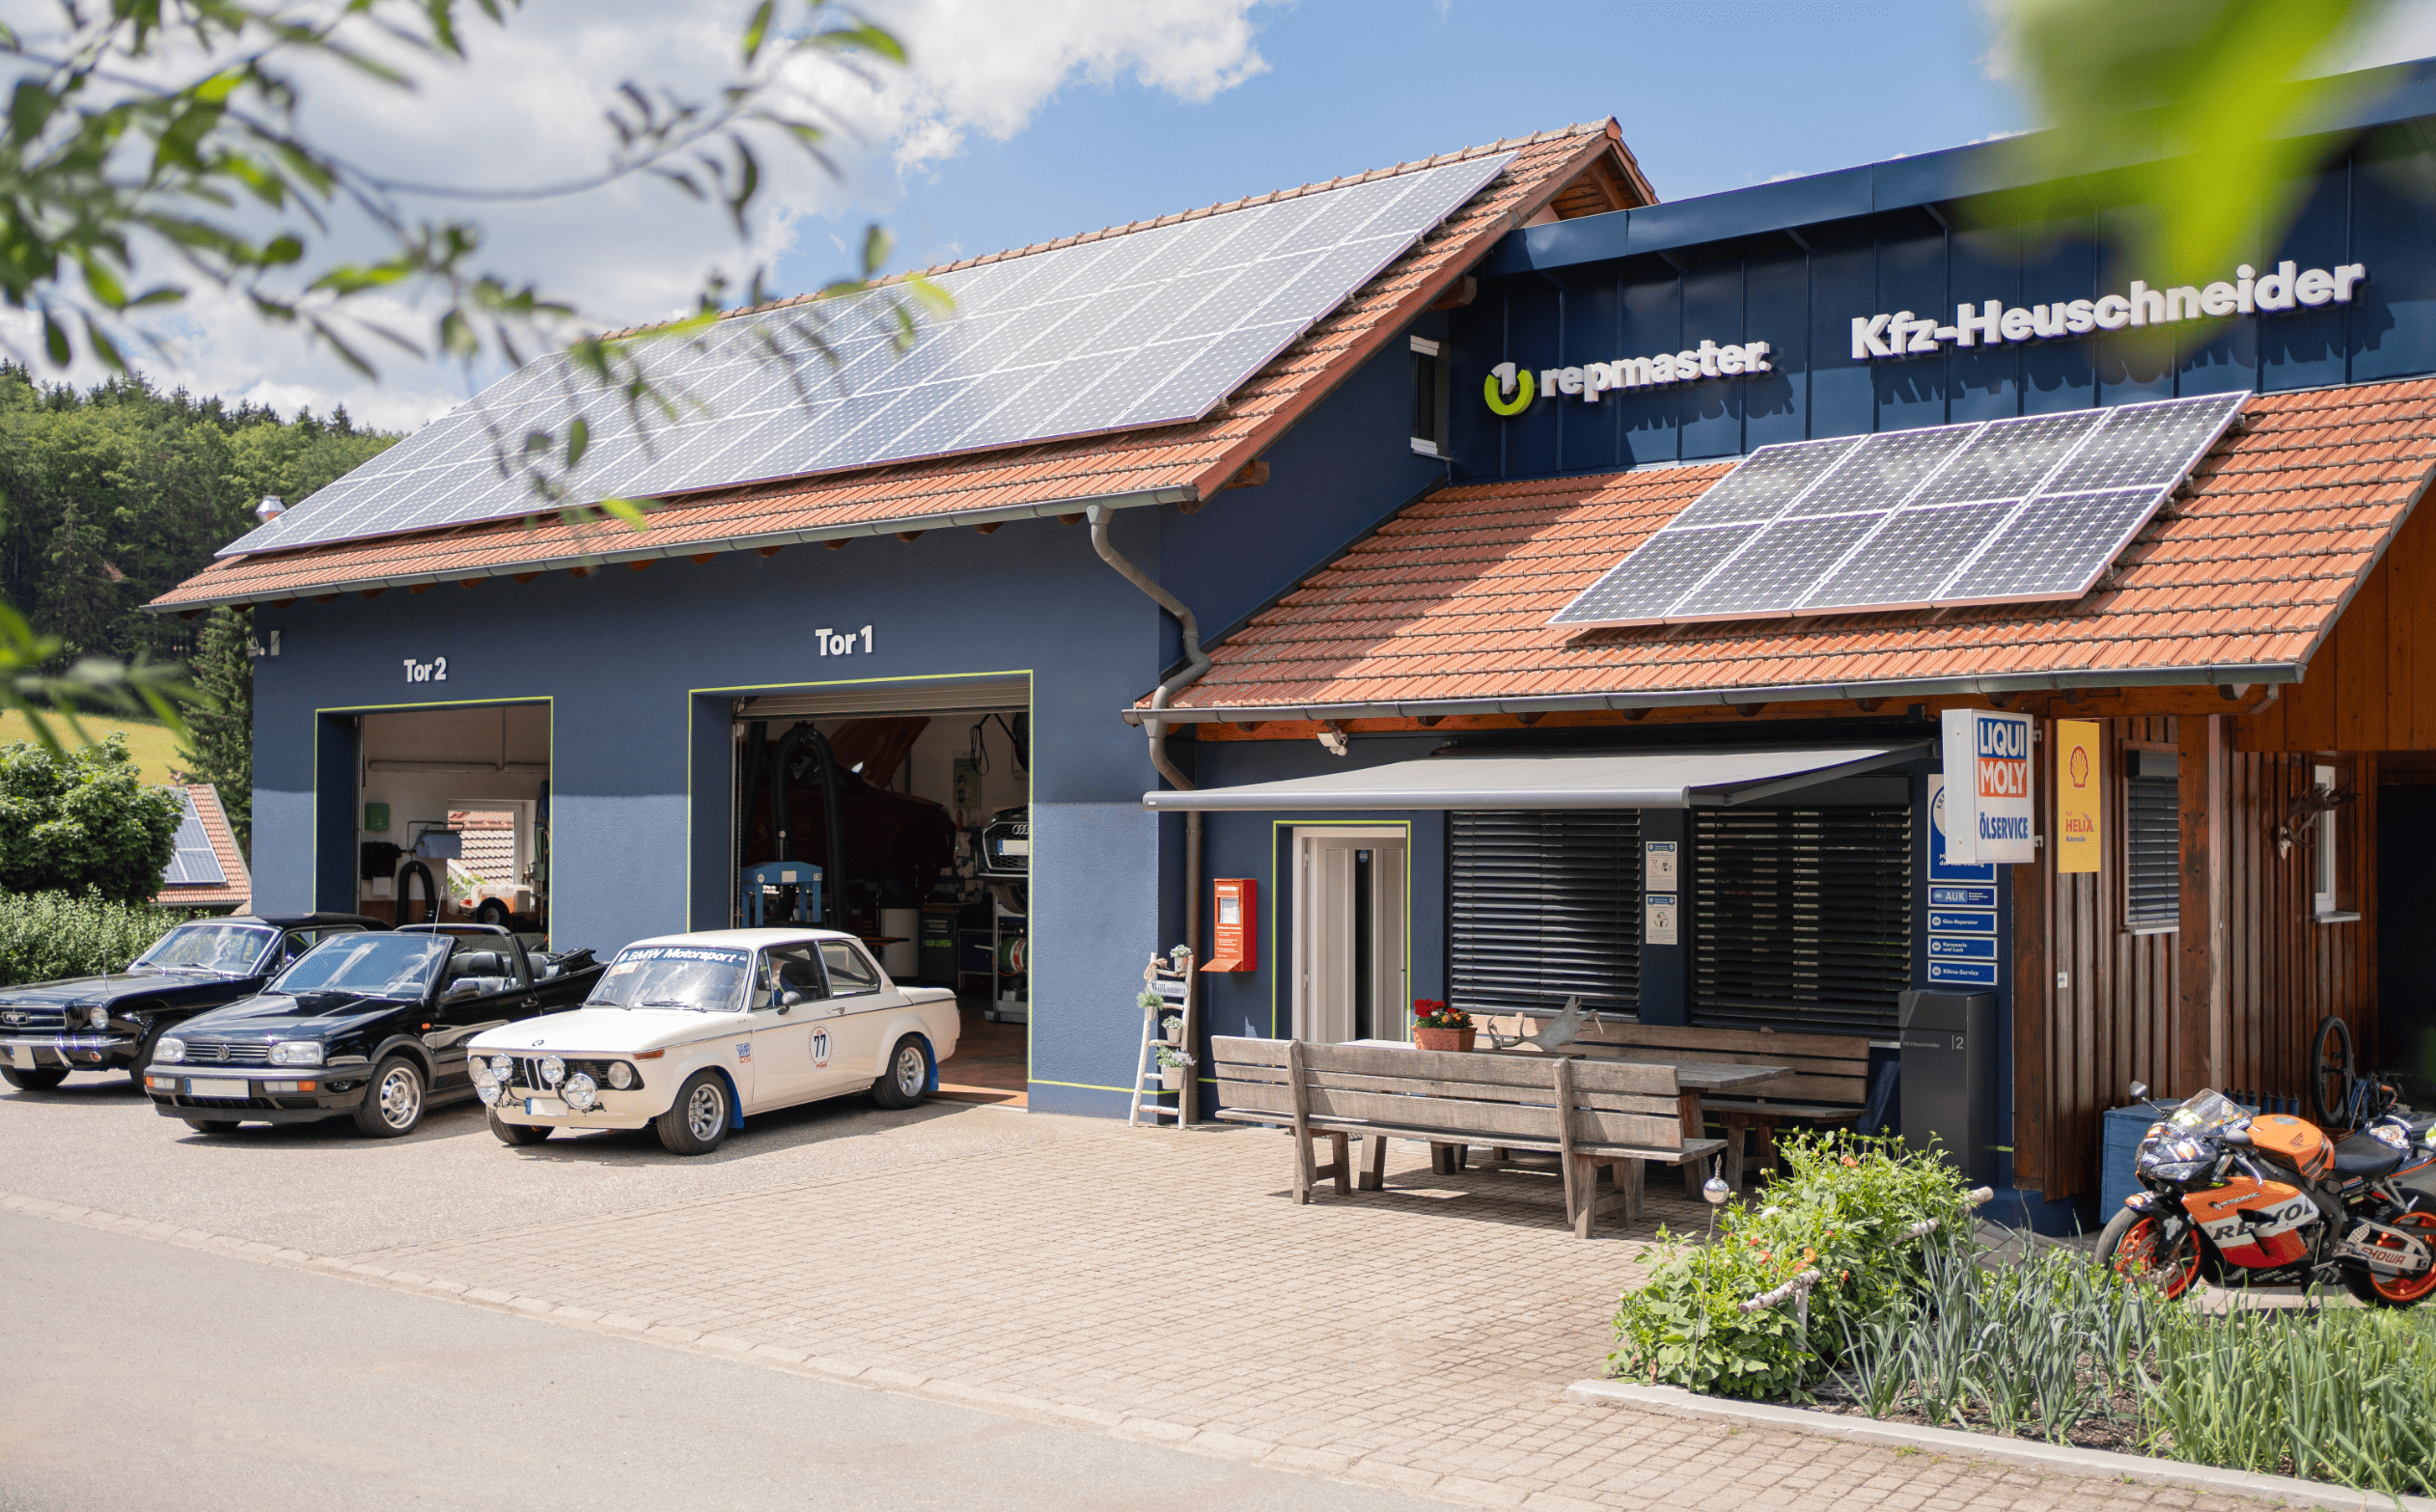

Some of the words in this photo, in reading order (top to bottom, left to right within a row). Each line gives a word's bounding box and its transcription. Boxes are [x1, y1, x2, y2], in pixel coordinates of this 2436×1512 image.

[1851, 261, 2365, 359] Kfz-Heuschneider
[1540, 340, 1772, 402] repmaster.
[815, 628, 856, 656] Tor
[860, 625, 872, 653] 1
[403, 659, 433, 682] Tor
[434, 656, 447, 681] 2
[1979, 721, 2025, 757] LIQUI
[1979, 760, 2027, 794] MOLY
[1979, 811, 2029, 839] ÖLSERVICE
[2065, 819, 2093, 833] HELIX
[1945, 892, 1965, 901] AUK
[627, 948, 665, 961] BMW
[663, 948, 736, 963] Motorsport
[814, 1033, 826, 1058] 77
